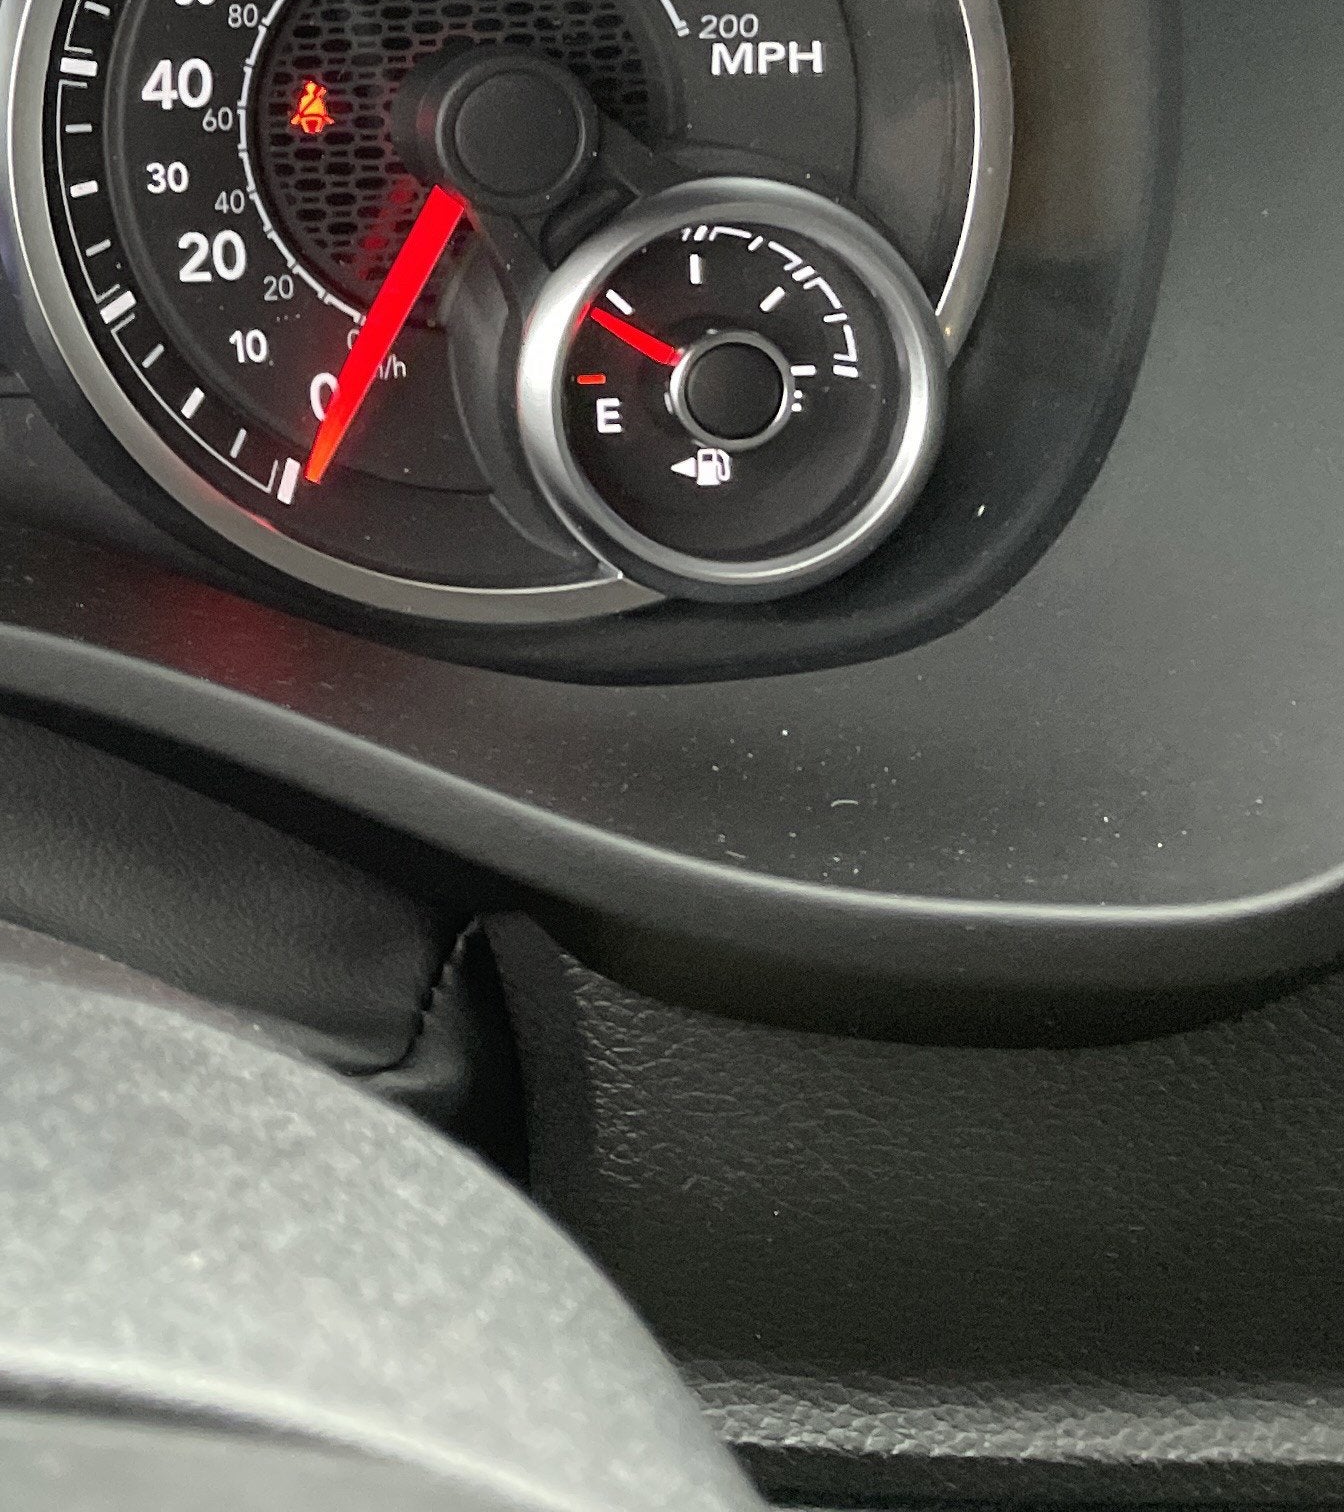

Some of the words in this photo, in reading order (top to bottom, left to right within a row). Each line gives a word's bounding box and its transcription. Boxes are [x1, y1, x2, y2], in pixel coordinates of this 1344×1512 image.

[228, 4, 258, 28] 80
[699, 14, 759, 39] 200
[711, 42, 823, 75] MPH
[141, 58, 213, 110] 40
[203, 108, 233, 131] 60
[146, 161, 189, 193] 30
[214, 189, 245, 214] 40
[178, 230, 246, 283] 20
[263, 274, 294, 301] 20
[228, 329, 268, 363] 10
[597, 397, 623, 433] E
